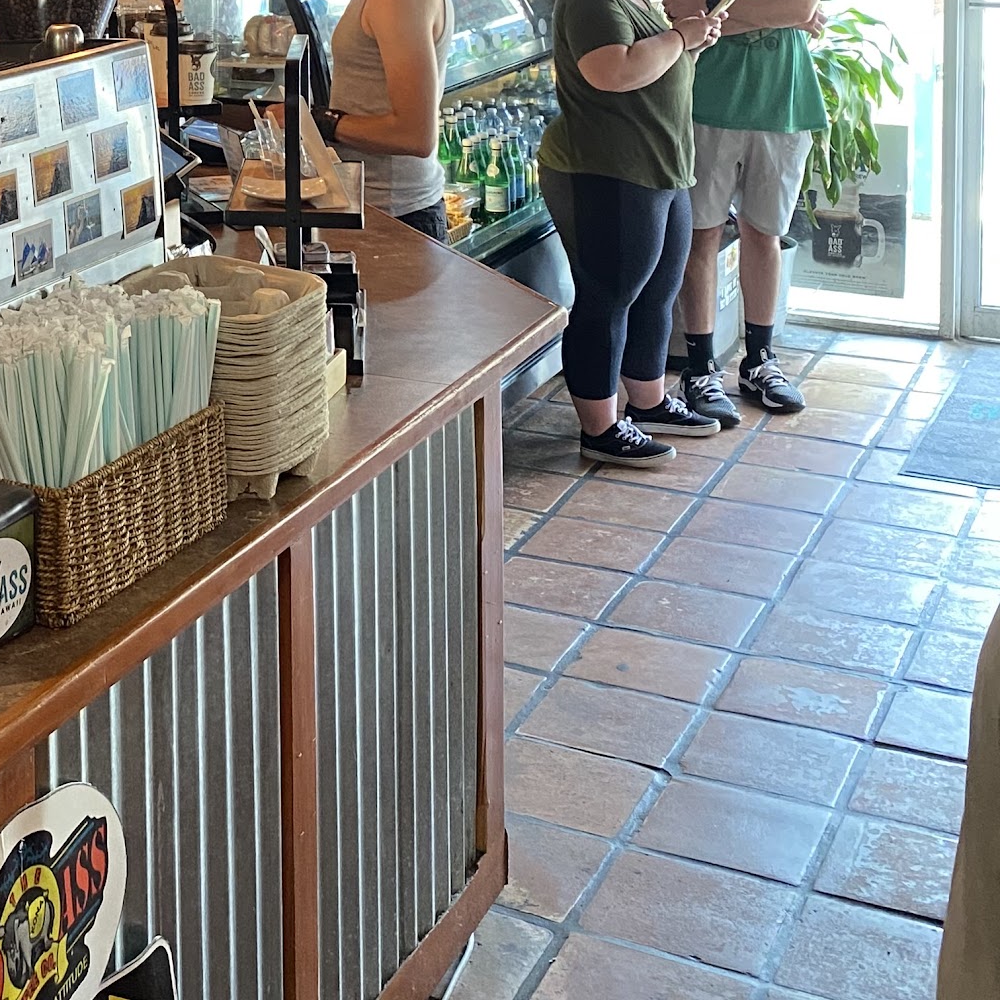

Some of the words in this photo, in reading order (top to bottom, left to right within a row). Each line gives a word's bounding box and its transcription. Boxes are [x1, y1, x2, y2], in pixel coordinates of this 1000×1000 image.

[188, 72, 205, 81] BAD
[188, 81, 205, 91] ASS
[828, 245, 843, 253] ASS
[31, 900, 44, 934] KONA
